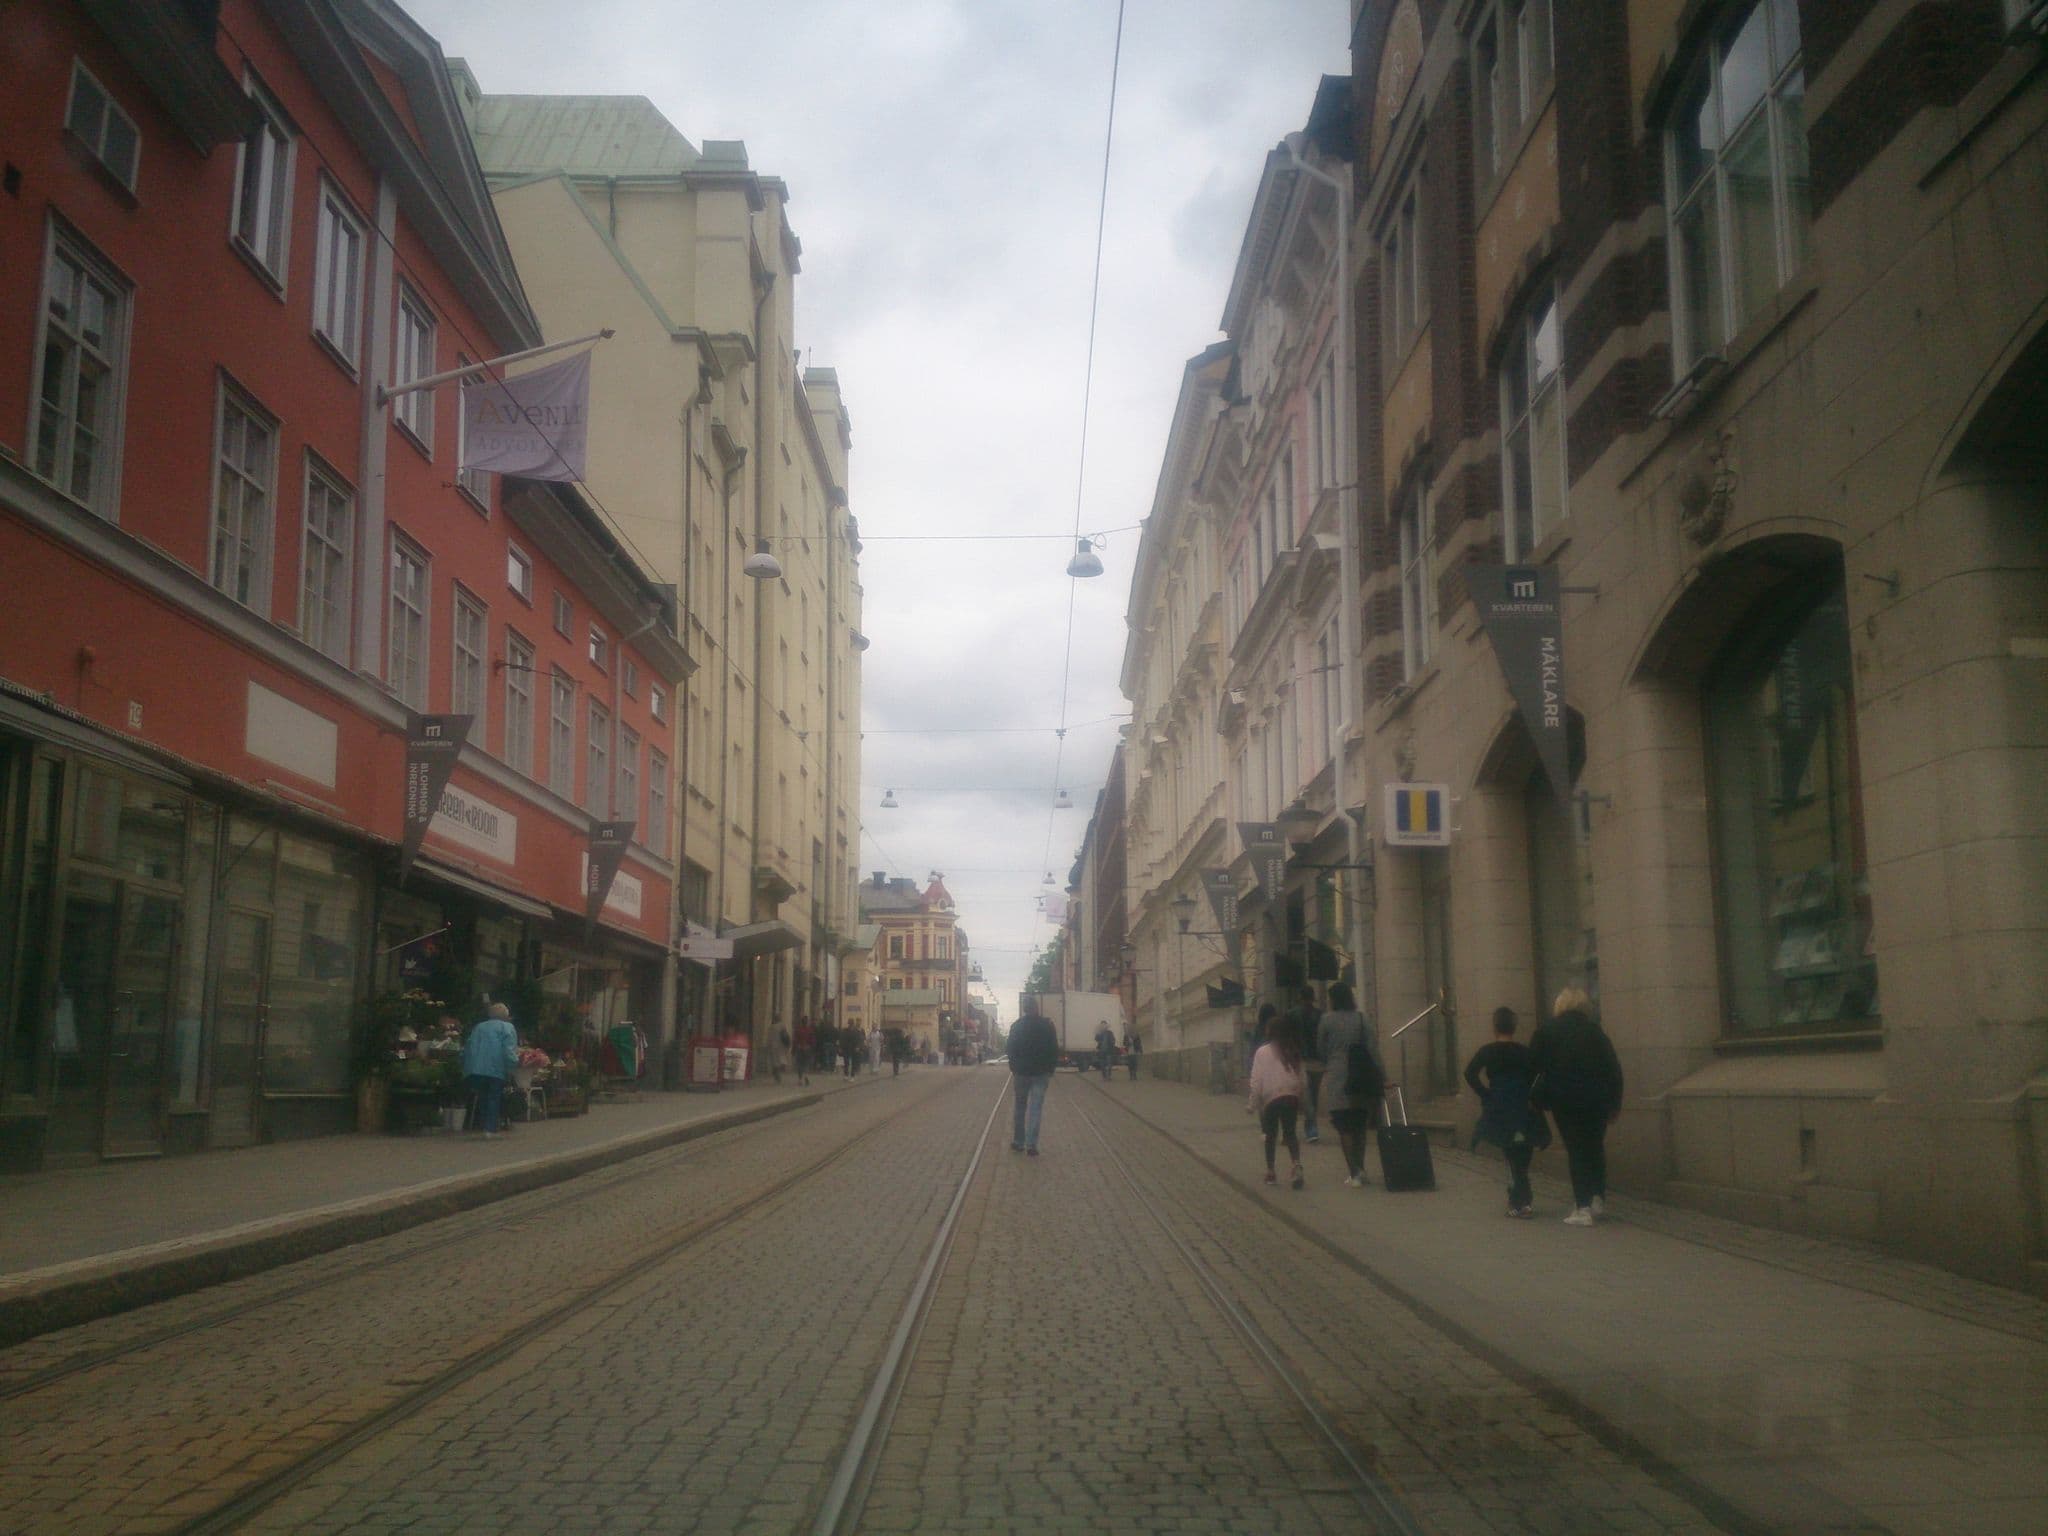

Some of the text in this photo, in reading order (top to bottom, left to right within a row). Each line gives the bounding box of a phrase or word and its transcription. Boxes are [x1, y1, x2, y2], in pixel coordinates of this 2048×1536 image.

[1491, 603, 1554, 613] KVARTEREN
[1539, 636, 1560, 728] MÄKLARE
[408, 762, 418, 819] INREDNING
[417, 762, 429, 814] BLOMMOR
